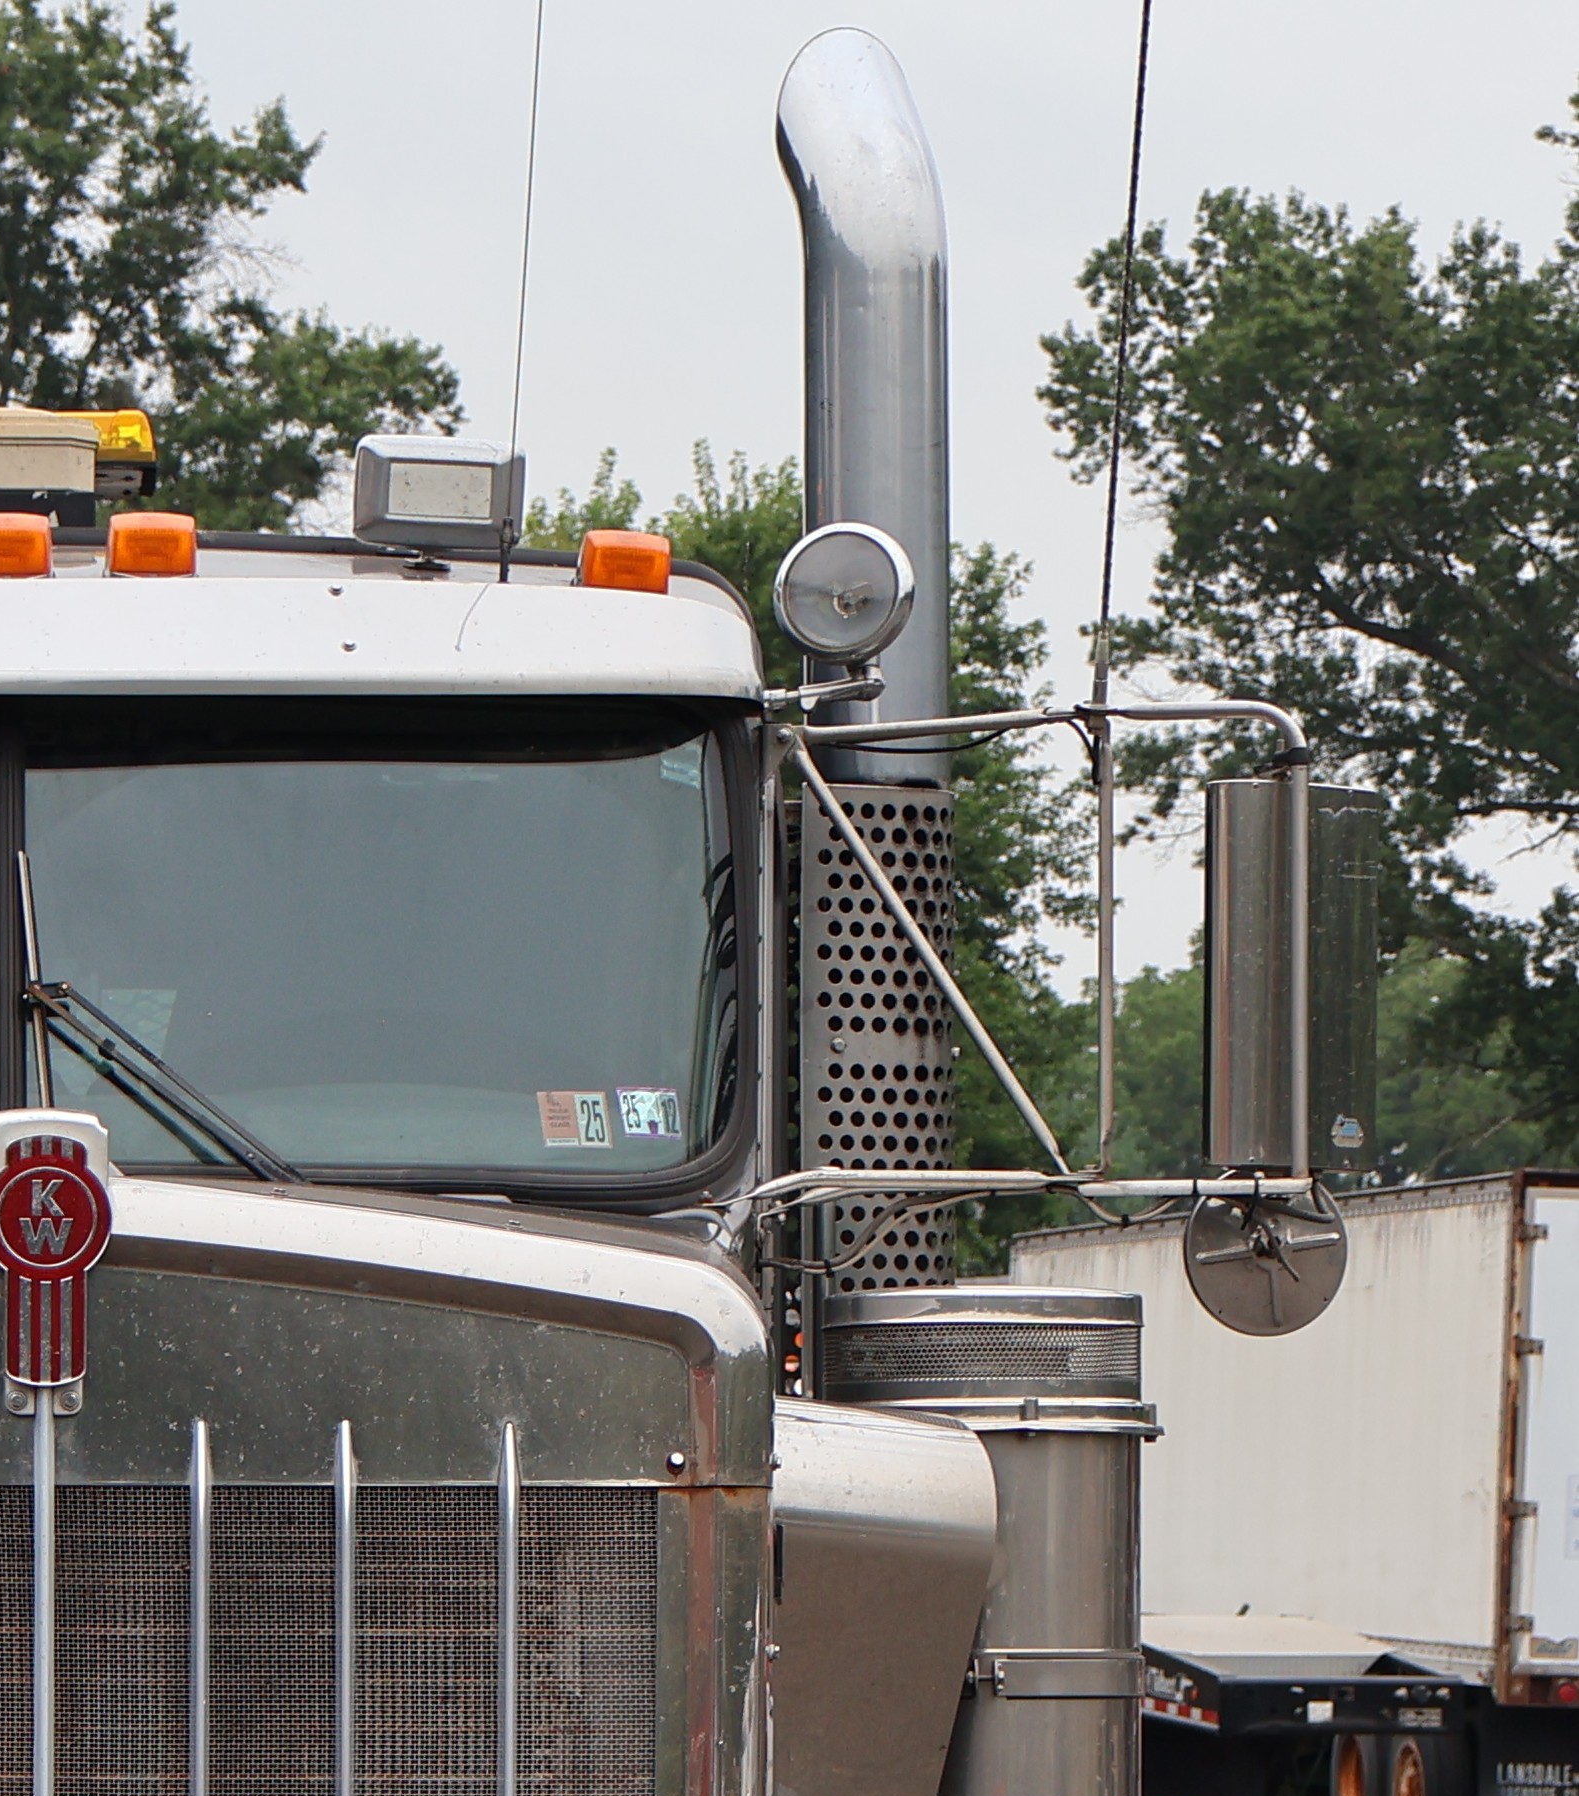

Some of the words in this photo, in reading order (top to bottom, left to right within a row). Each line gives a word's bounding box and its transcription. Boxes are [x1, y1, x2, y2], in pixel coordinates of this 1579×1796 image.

[580, 1099, 606, 1143] 25
[623, 1094, 641, 1129] 25
[660, 1097, 680, 1134] 12
[31, 1179, 65, 1217] K
[19, 1217, 74, 1255] W
